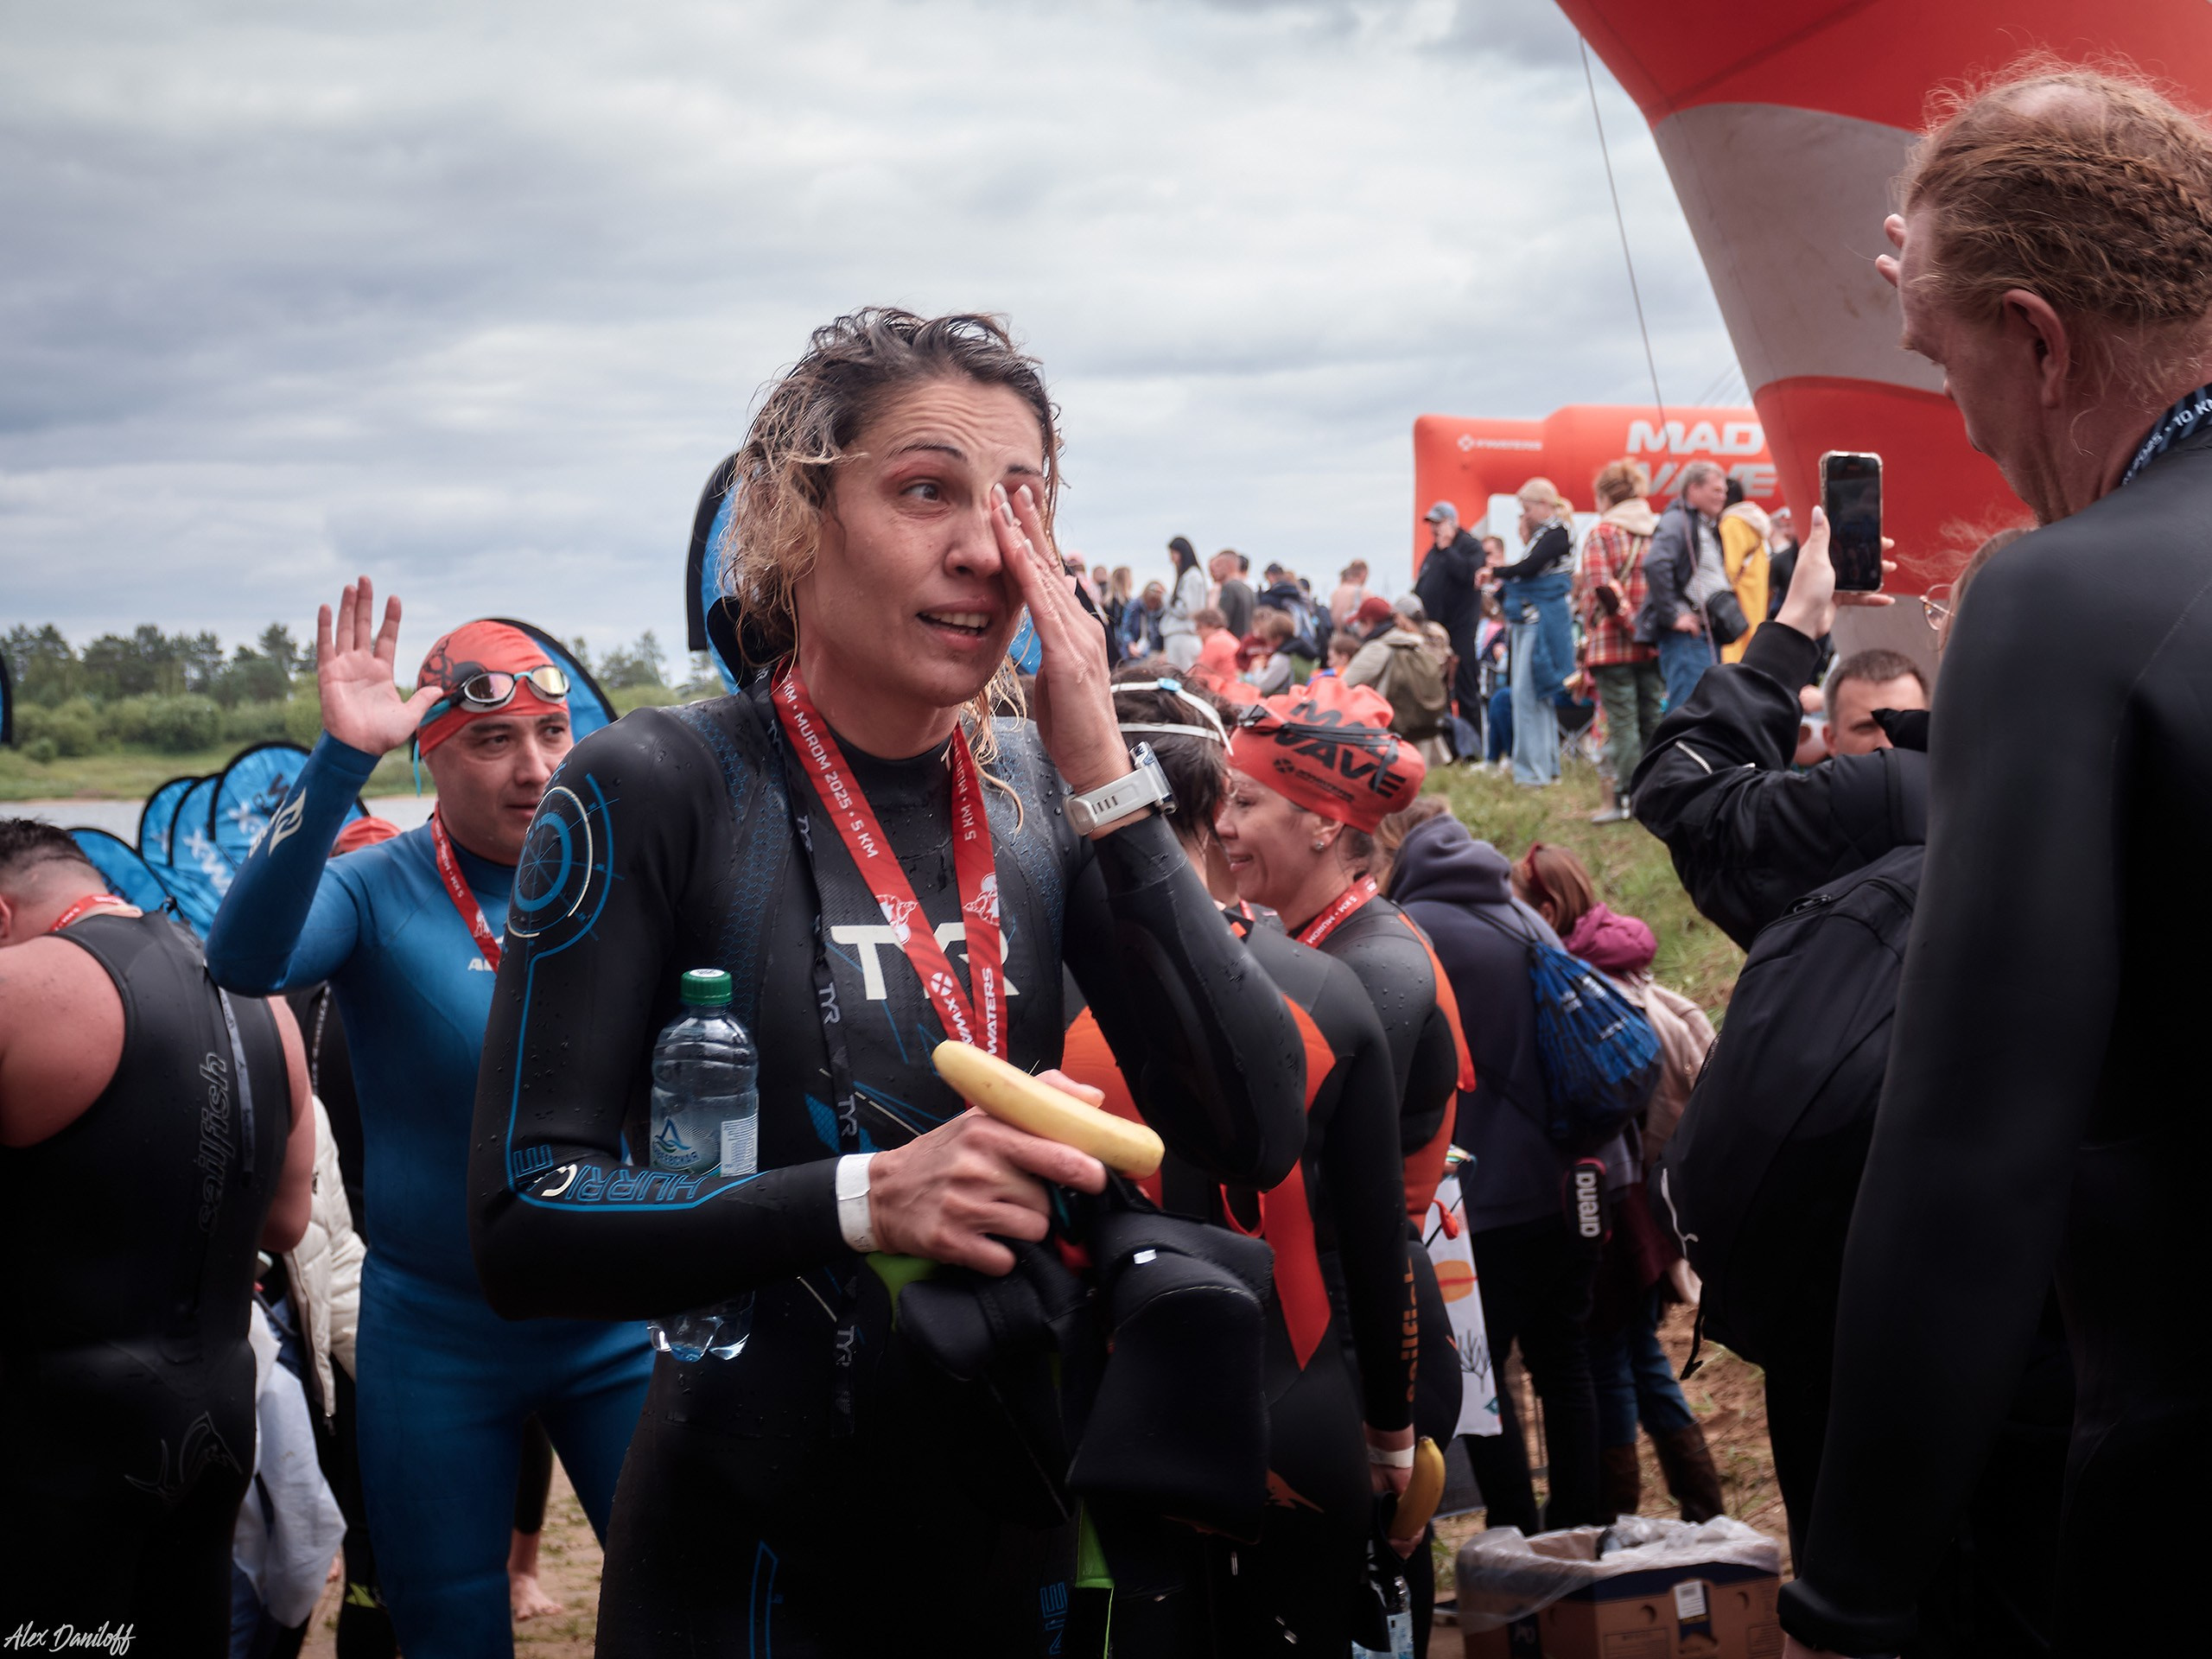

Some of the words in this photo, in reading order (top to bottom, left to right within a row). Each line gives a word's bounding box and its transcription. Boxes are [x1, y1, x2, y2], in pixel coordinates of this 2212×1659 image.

[1626, 420, 1767, 455] MAD
[2171, 409, 2194, 428] 10
[783, 681, 798, 704] KM
[794, 711, 832, 772] MUROM
[824, 770, 853, 810] 2025
[849, 819, 865, 832] 5
[857, 831, 880, 859] KM
[960, 804, 975, 829] KM
[963, 830, 977, 842] 5
[818, 982, 842, 1026] TYR
[836, 1094, 858, 1138] TYR
[198, 1051, 236, 1238] sailfish
[512, 1143, 708, 1202] HURRICE
[1575, 1171, 1601, 1238] arena
[836, 1325, 855, 1369] TYR
